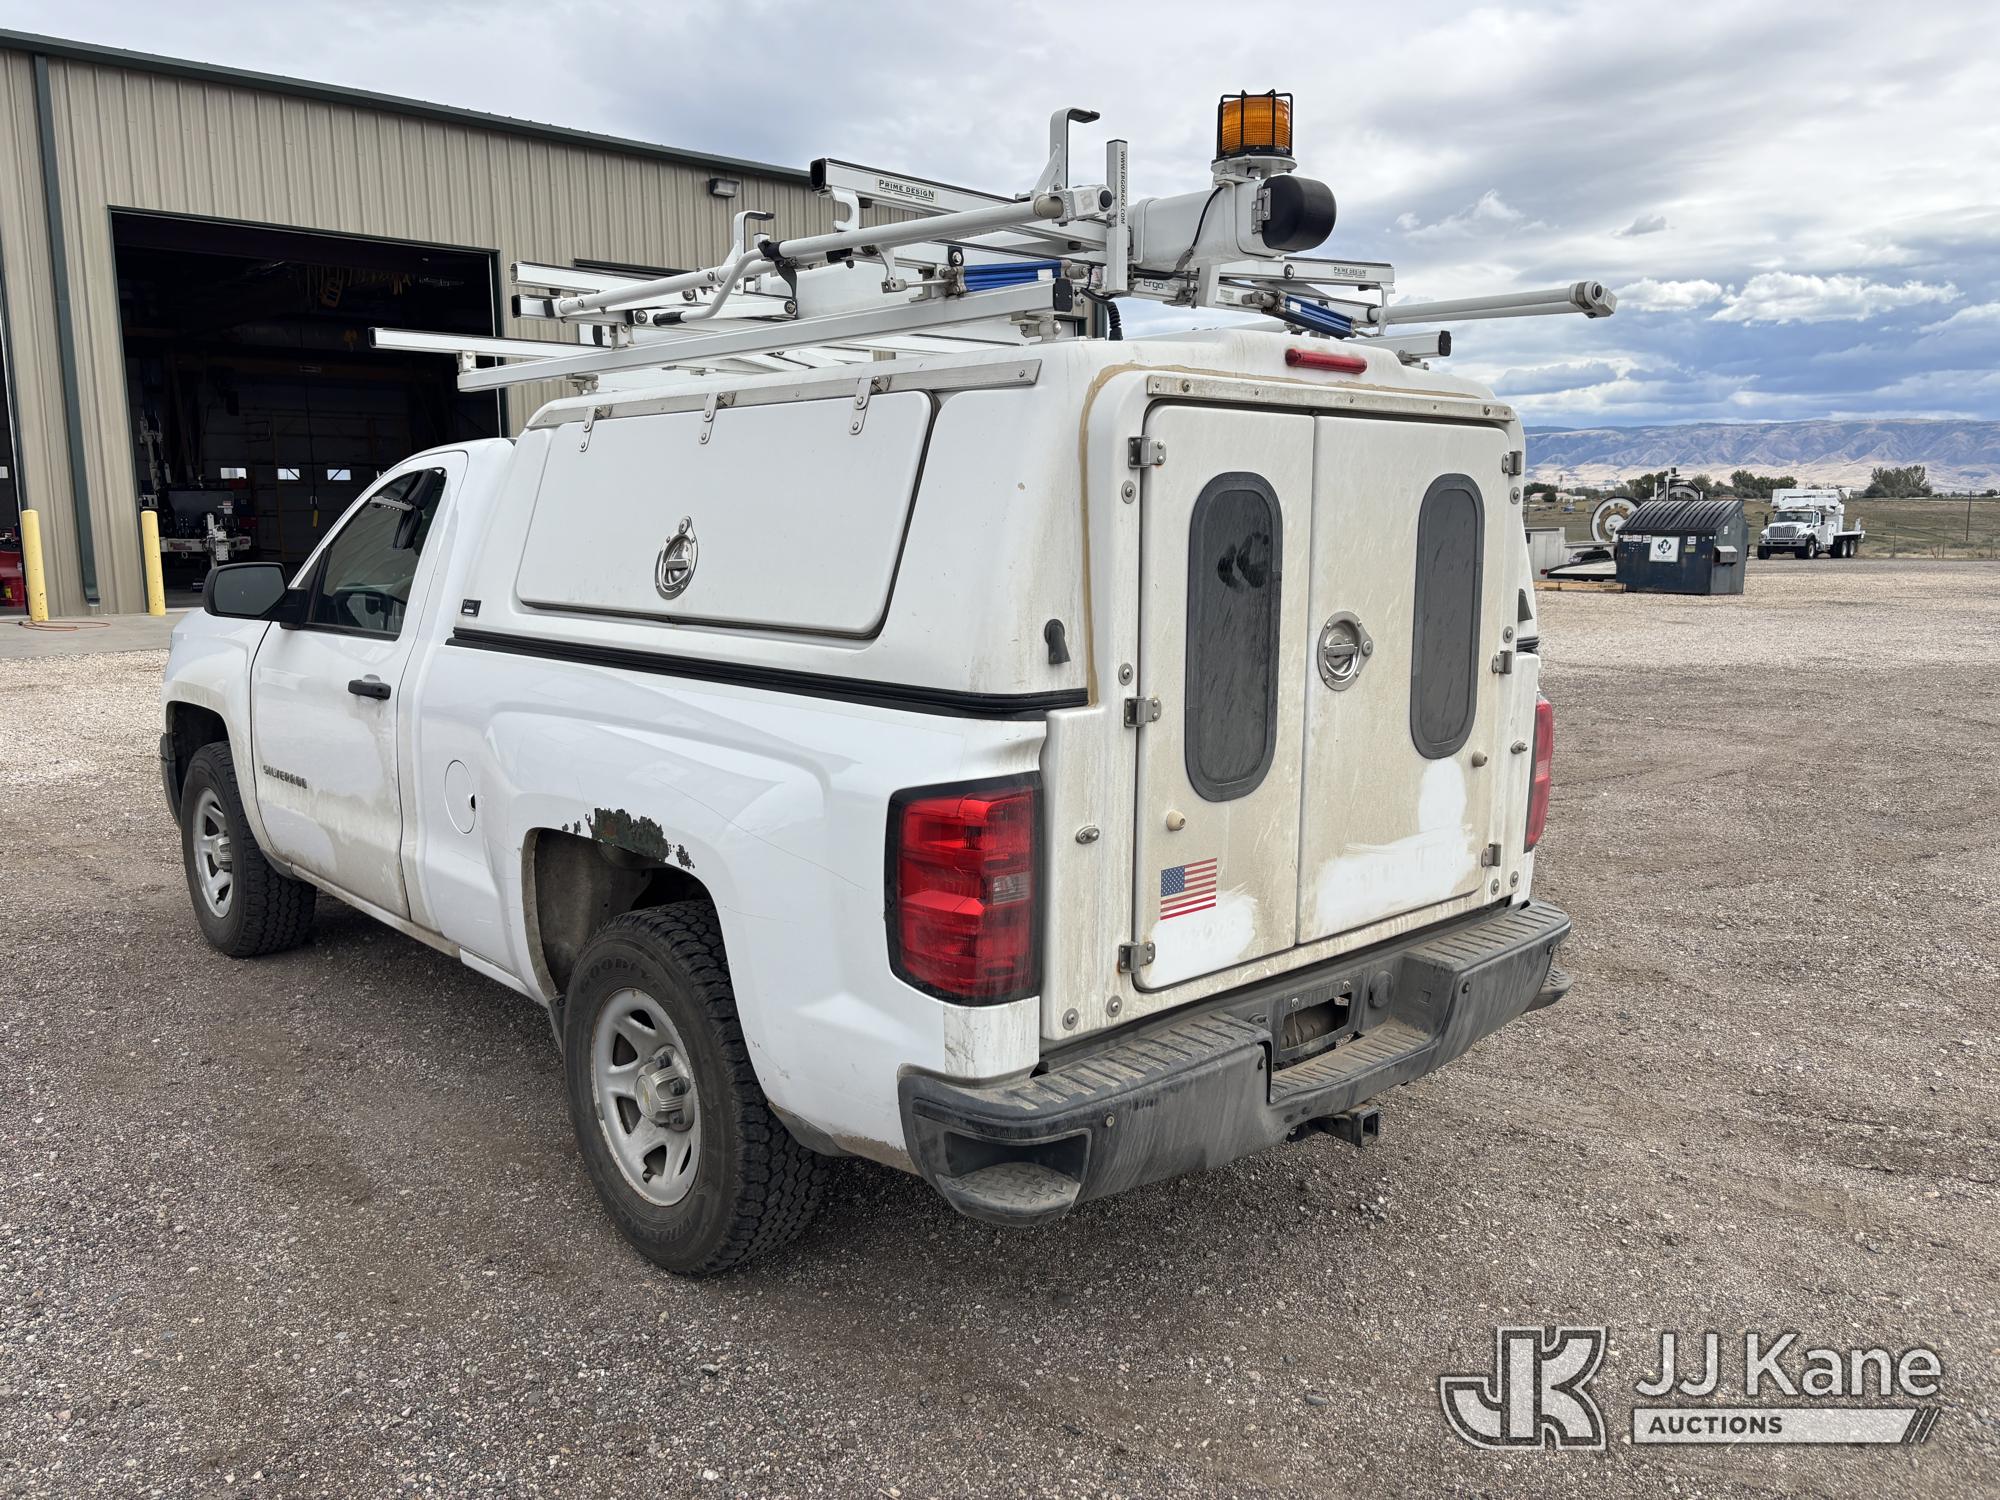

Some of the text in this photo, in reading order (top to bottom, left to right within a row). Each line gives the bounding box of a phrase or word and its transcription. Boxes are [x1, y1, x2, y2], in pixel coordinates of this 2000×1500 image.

[879, 180, 903, 191] PRIME
[906, 187, 934, 197] DESIGN
[262, 764, 308, 790] SILVERADO
